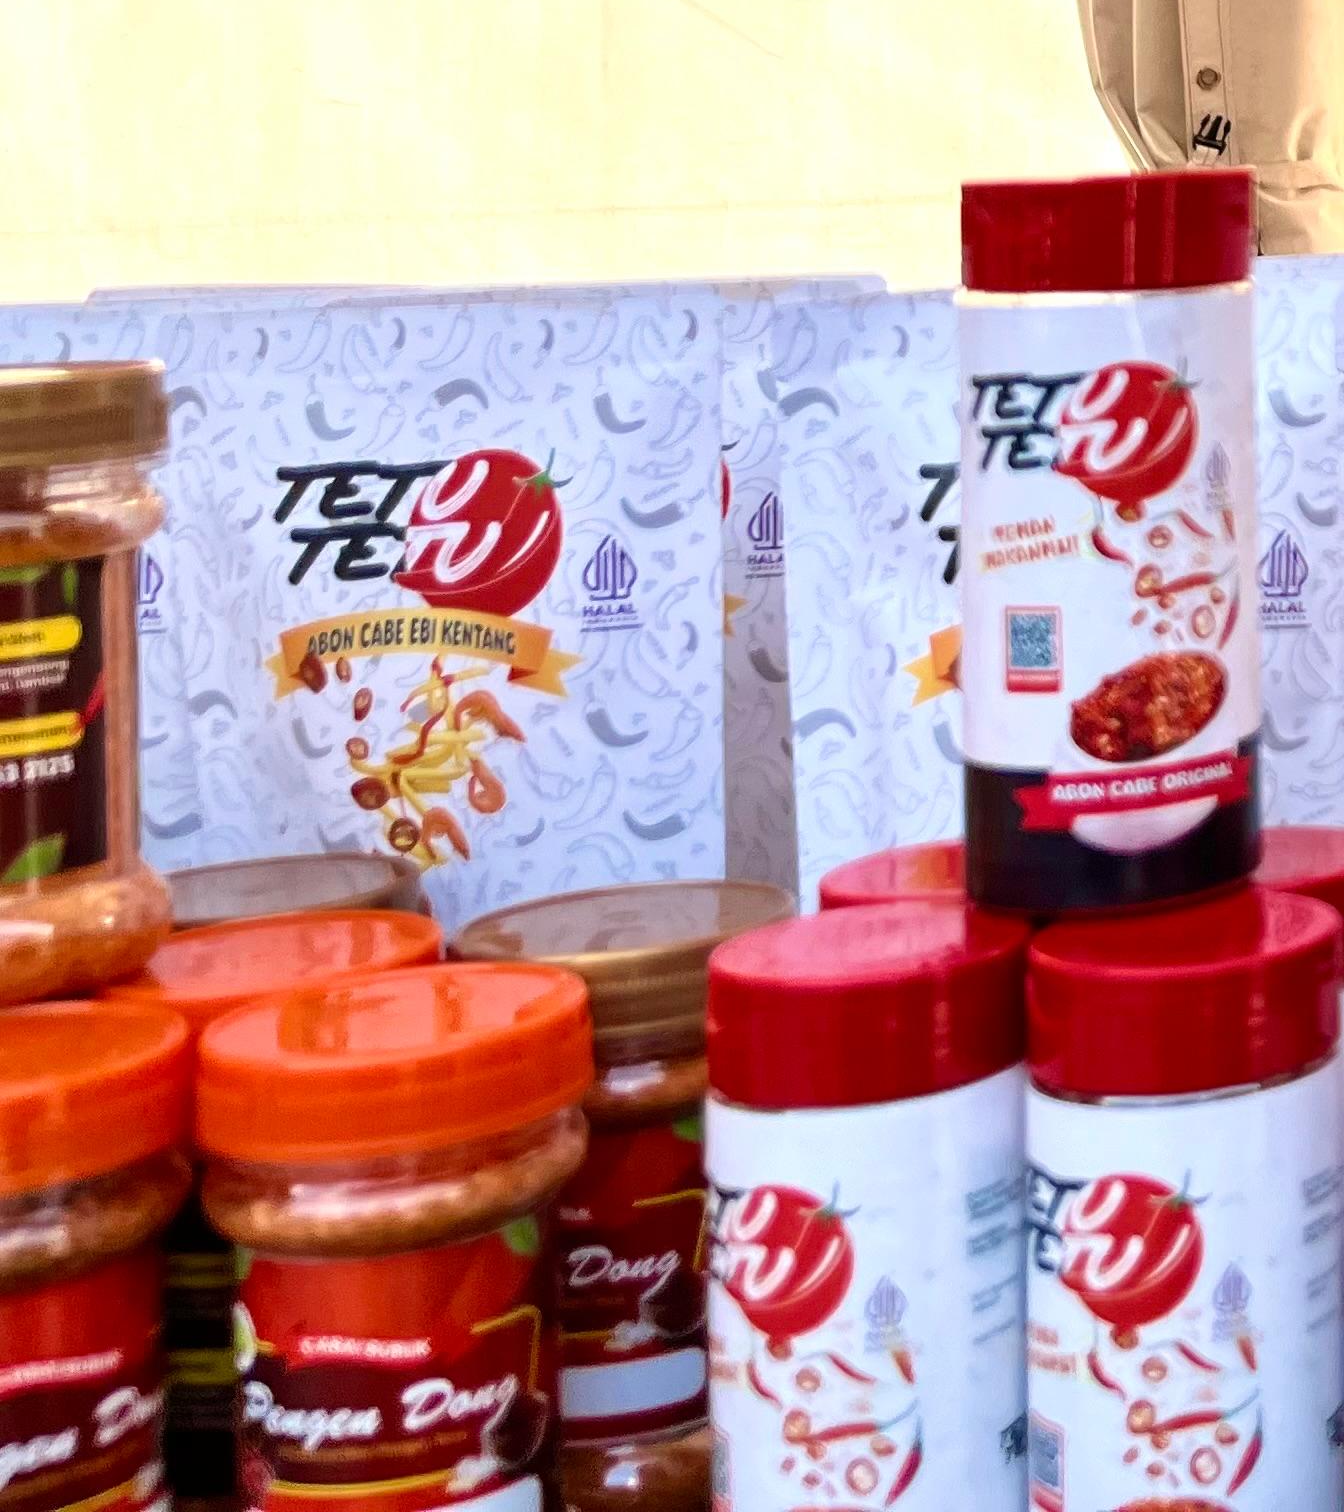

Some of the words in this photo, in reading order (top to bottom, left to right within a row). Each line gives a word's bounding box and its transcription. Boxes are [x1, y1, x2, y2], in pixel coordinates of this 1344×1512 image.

[307, 626, 355, 656] ABON
[360, 618, 404, 648] CABE
[410, 617, 436, 645] EBI
[441, 620, 516, 655] KENTANG
[1110, 776, 1158, 795] CABE
[567, 1245, 681, 1303] Dong
[401, 1374, 519, 1434] Dong
